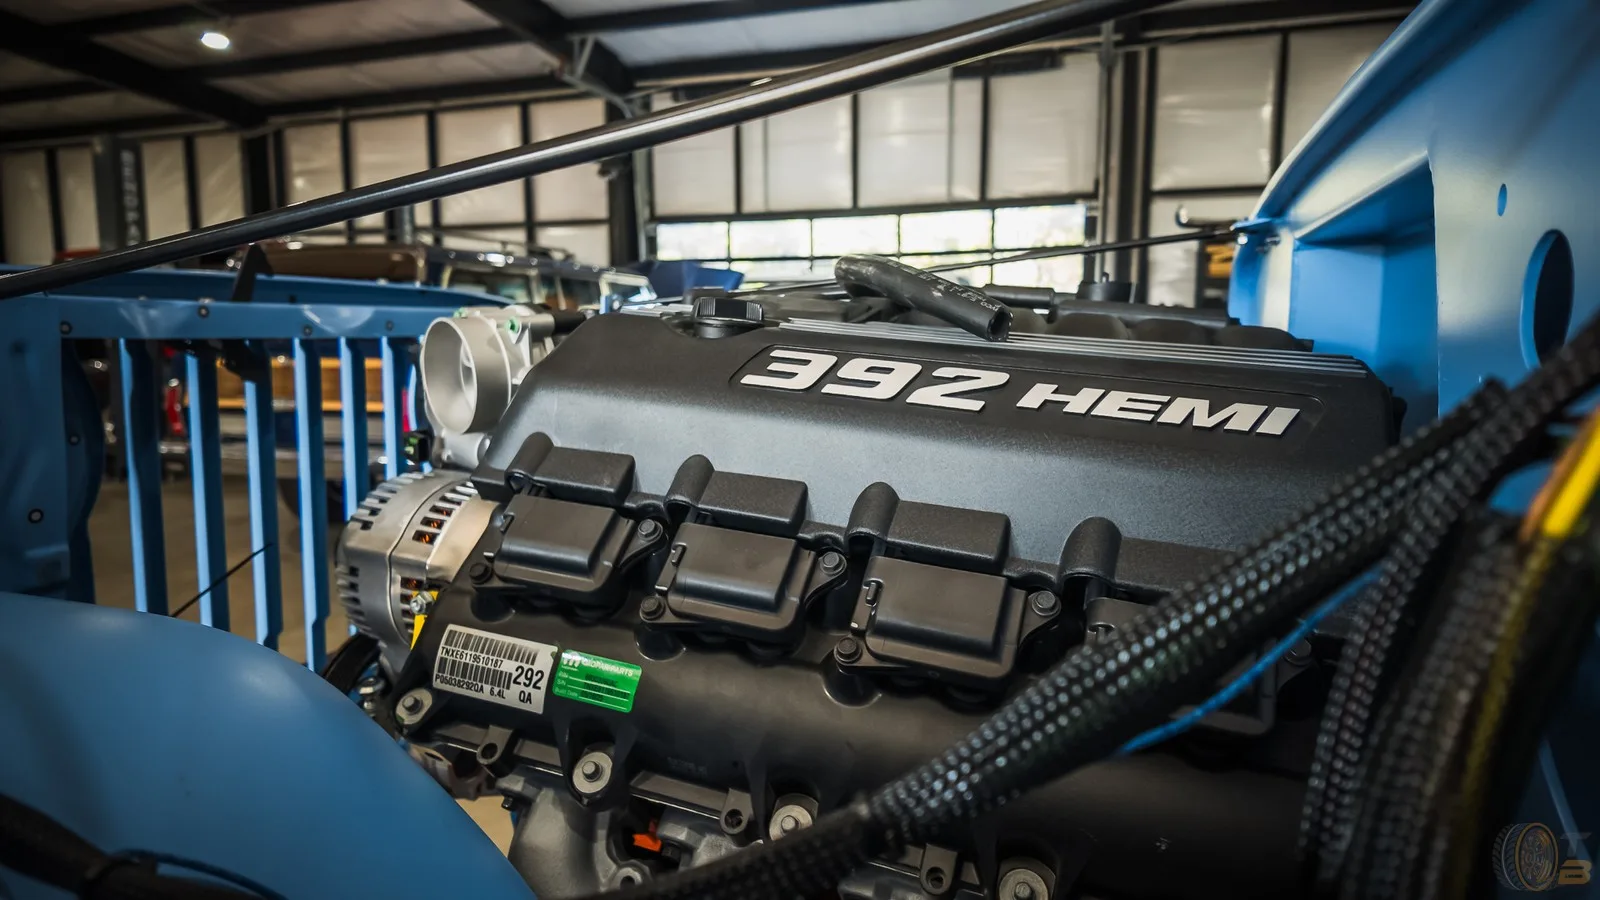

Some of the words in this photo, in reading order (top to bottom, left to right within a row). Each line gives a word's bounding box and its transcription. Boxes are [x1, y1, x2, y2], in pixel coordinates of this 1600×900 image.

[739, 349, 1010, 412] 392
[1016, 382, 1301, 436] HEMI
[512, 665, 545, 690] 292
[489, 687, 506, 700] 6.4L
[518, 690, 533, 705] QA
